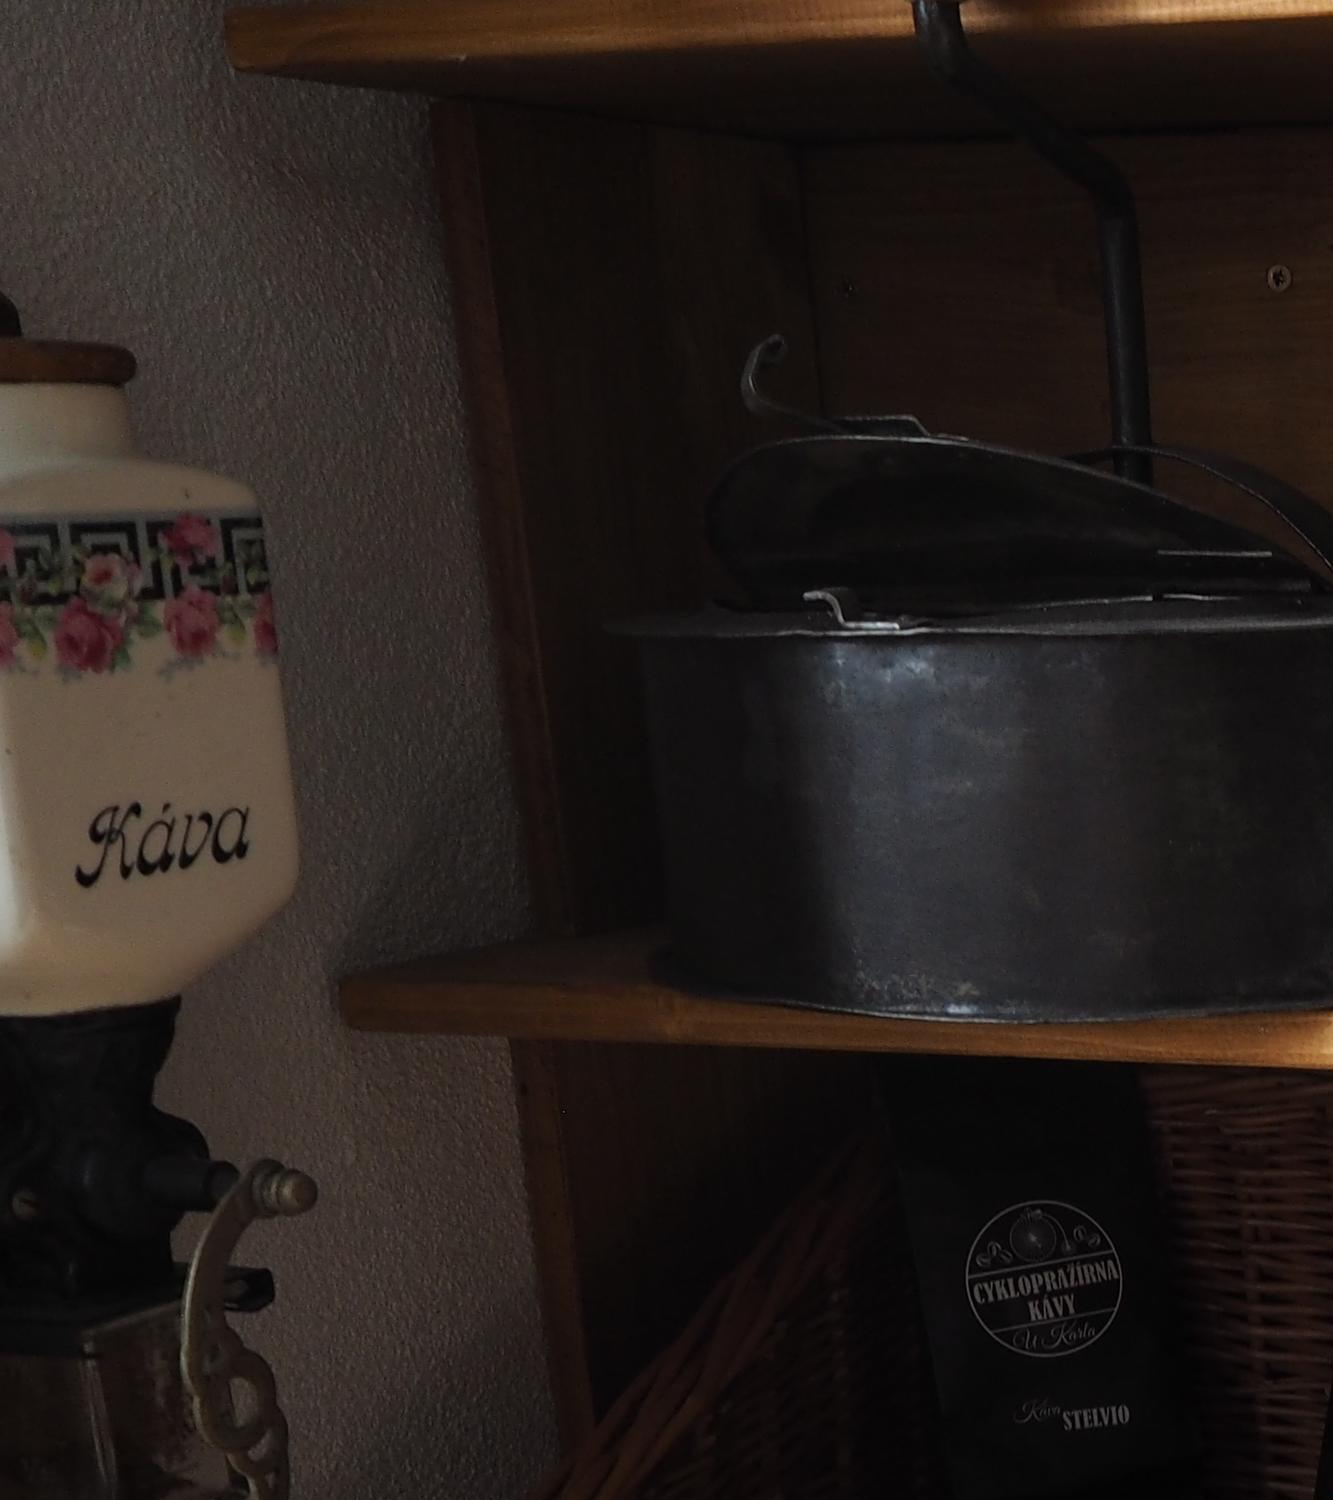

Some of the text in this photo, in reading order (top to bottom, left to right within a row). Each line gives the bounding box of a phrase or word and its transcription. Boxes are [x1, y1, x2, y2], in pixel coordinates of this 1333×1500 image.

[75, 801, 250, 889] Káva
[972, 1257, 1120, 1305] CYKLOPRAŽÍRNA
[1027, 1293, 1077, 1322] KÁVY
[1061, 1404, 1131, 1432] STELVIO
